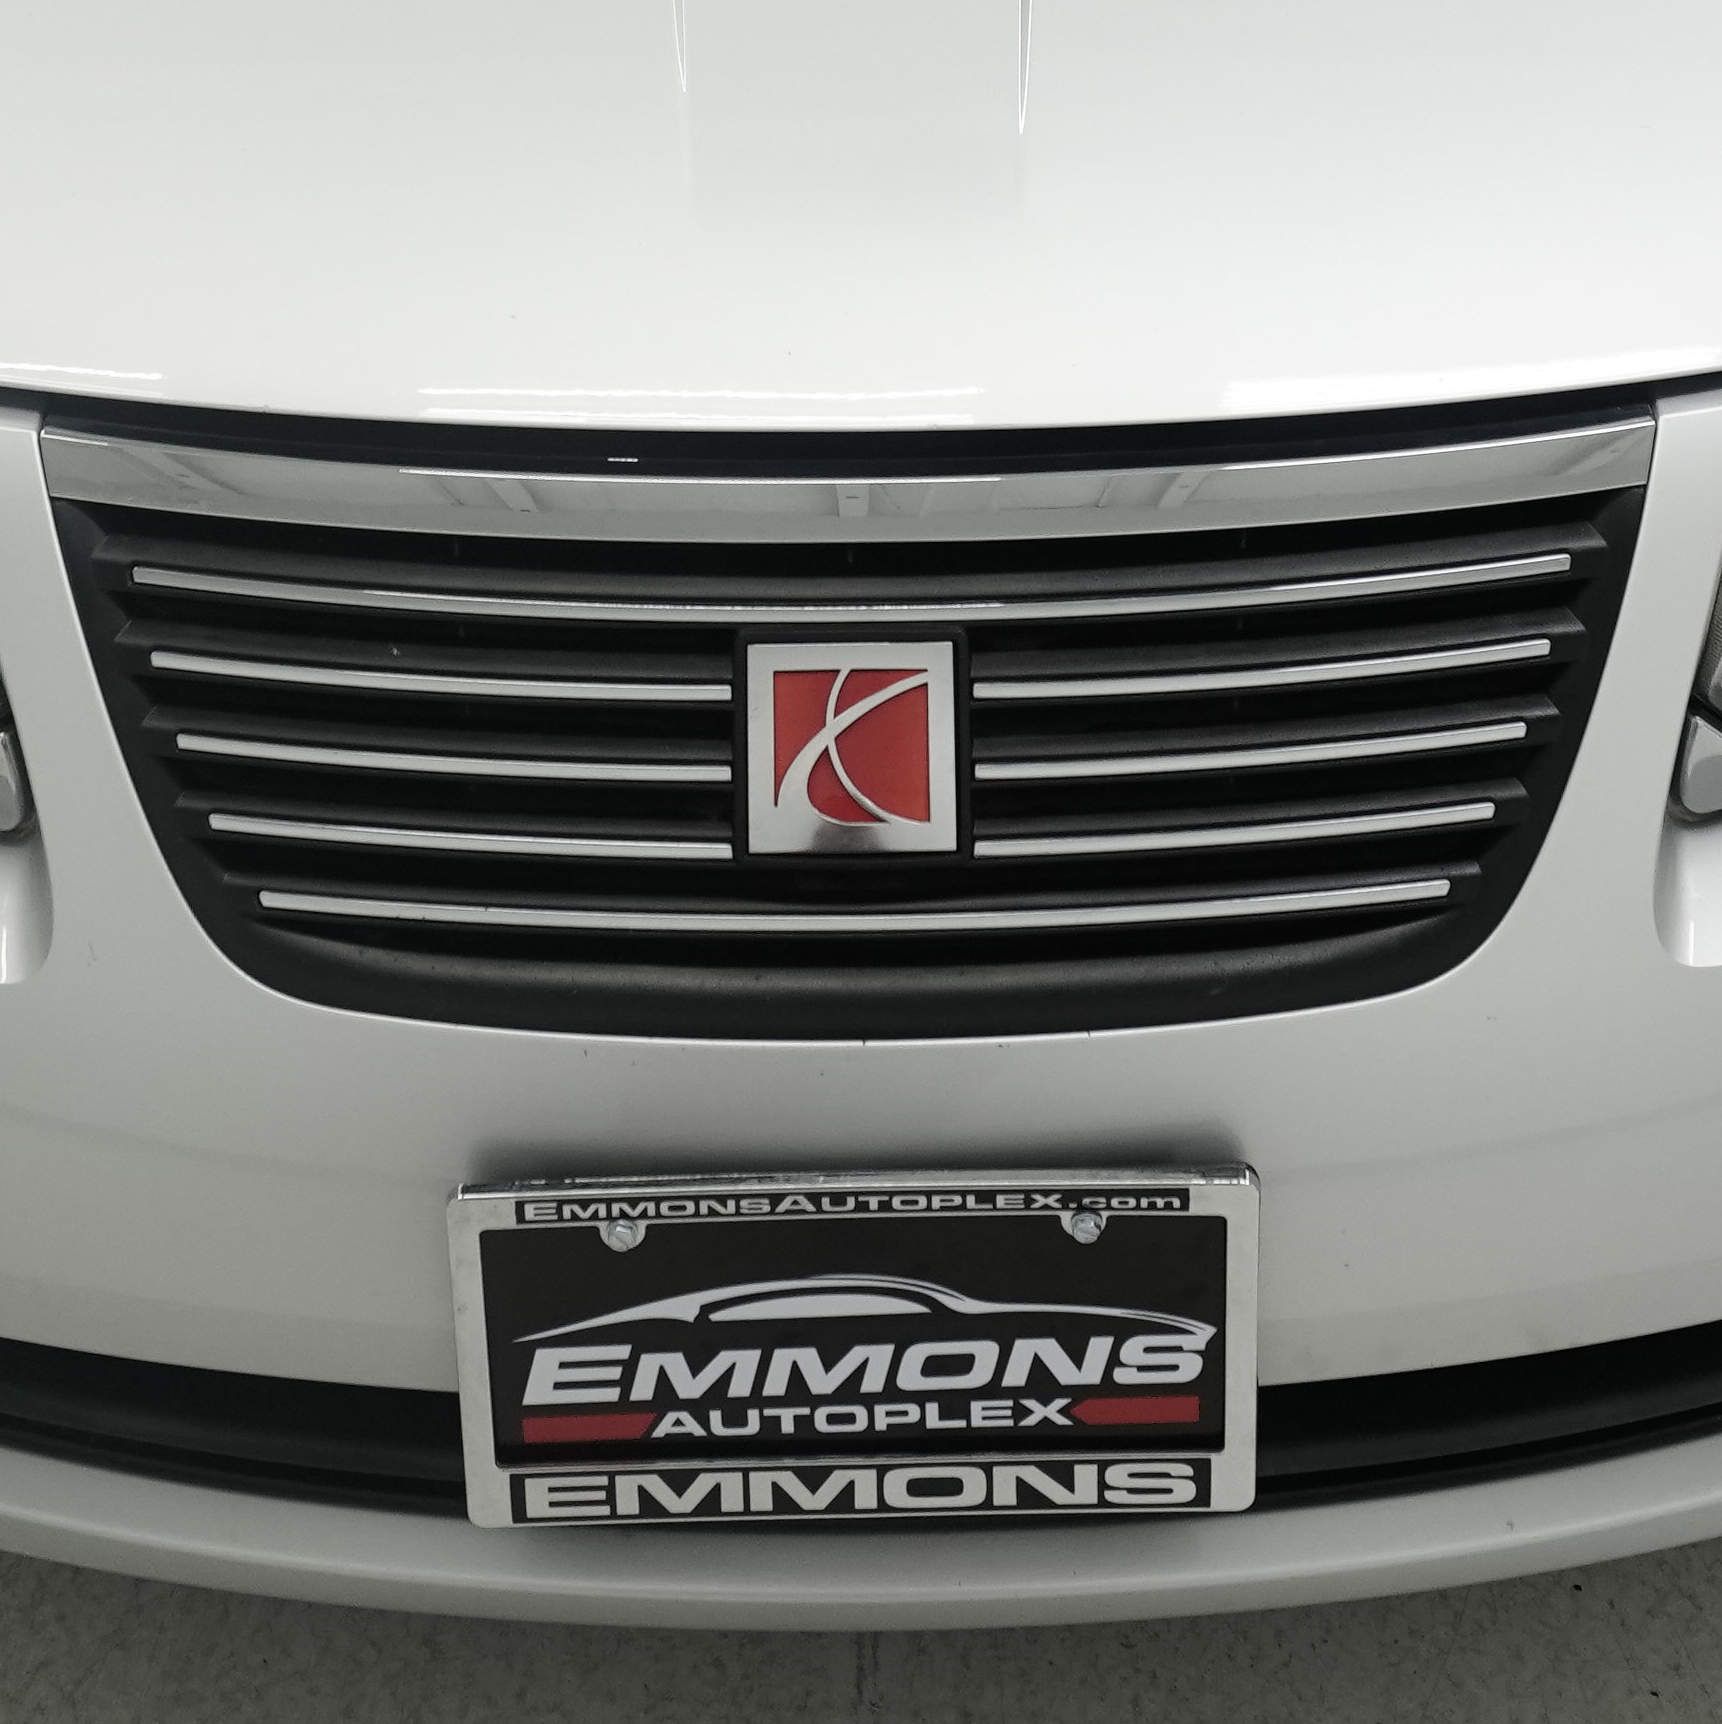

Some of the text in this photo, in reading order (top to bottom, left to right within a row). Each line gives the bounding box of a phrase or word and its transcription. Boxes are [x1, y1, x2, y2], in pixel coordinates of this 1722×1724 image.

[522, 1334, 1204, 1406] EMMONS
[651, 1398, 1075, 1438] AUTOPLEX
[525, 1462, 1198, 1519] EMMONS
